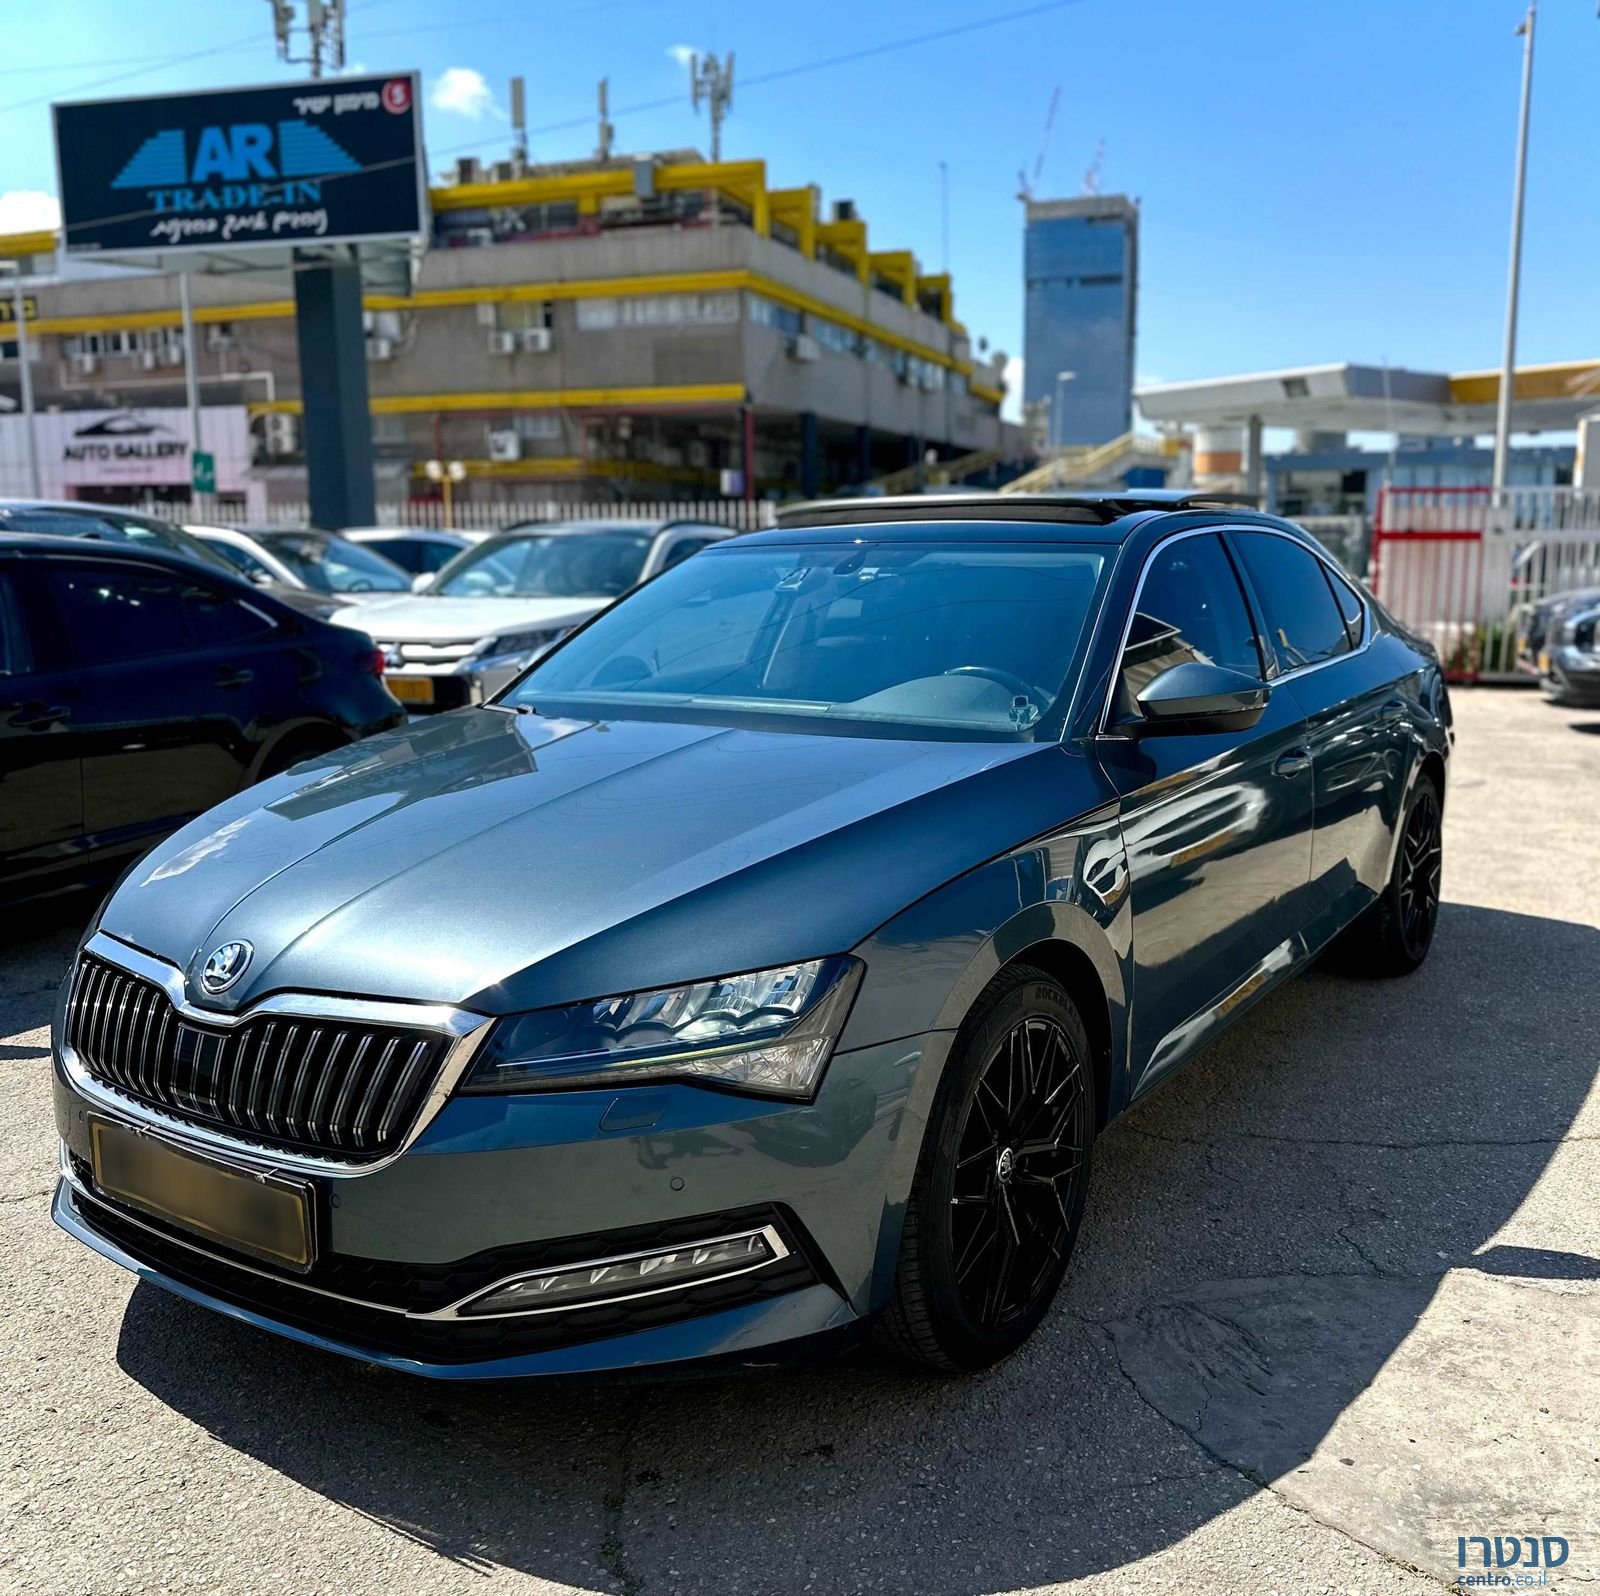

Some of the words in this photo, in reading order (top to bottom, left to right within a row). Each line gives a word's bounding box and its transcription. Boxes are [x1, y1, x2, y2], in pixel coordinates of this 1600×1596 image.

[192, 123, 278, 182] AR
[148, 181, 322, 213] TRADE-IN
[64, 444, 110, 462] AUTO
[115, 441, 188, 459] GALLERY
